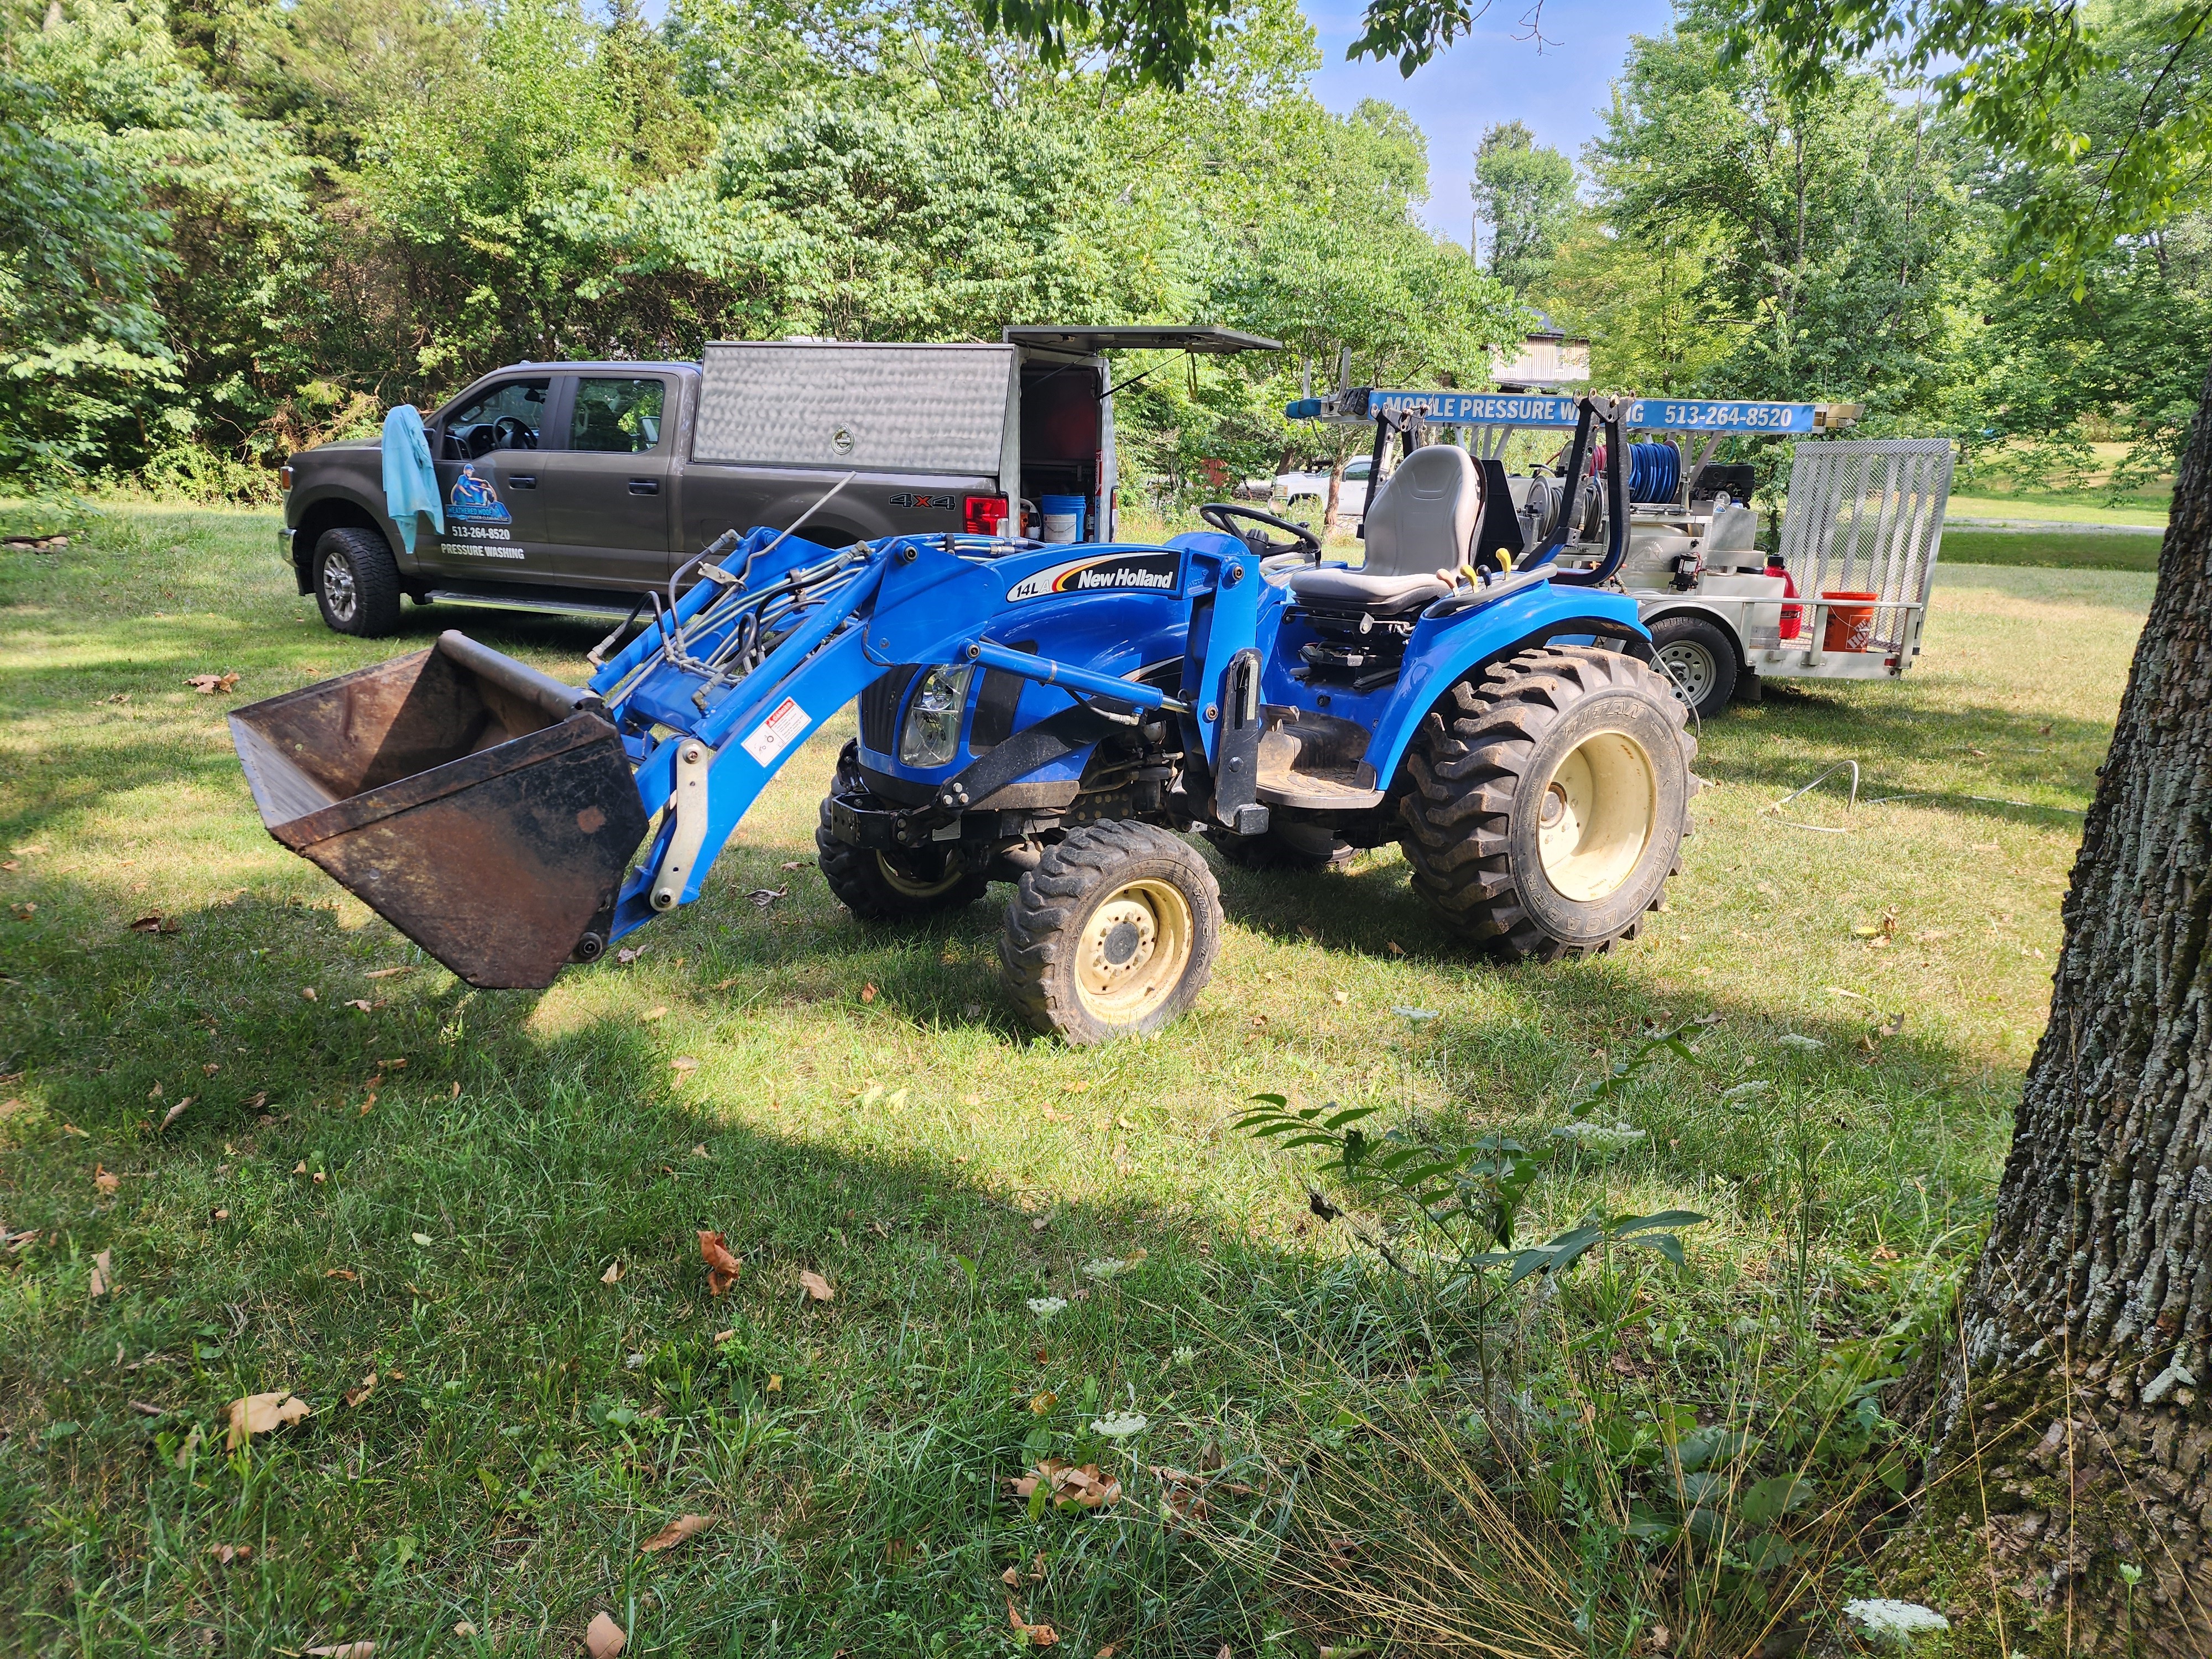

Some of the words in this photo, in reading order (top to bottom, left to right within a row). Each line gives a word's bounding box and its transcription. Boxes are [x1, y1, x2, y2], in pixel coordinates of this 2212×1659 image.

[1460, 398, 1556, 420] PRESSURE
[1665, 405, 1792, 427] 513-264-8520
[452, 526, 510, 540] 513-264-8520
[441, 543, 484, 556] PRESSURE
[484, 546, 525, 559] WASHING
[1078, 570, 1115, 589] New
[1114, 568, 1173, 588] Holland
[1564, 700, 1646, 740] TITAN
[1629, 828, 1676, 913] TRAC
[1525, 872, 1617, 933] LOADER
[1171, 947, 1207, 1014] LOAD
